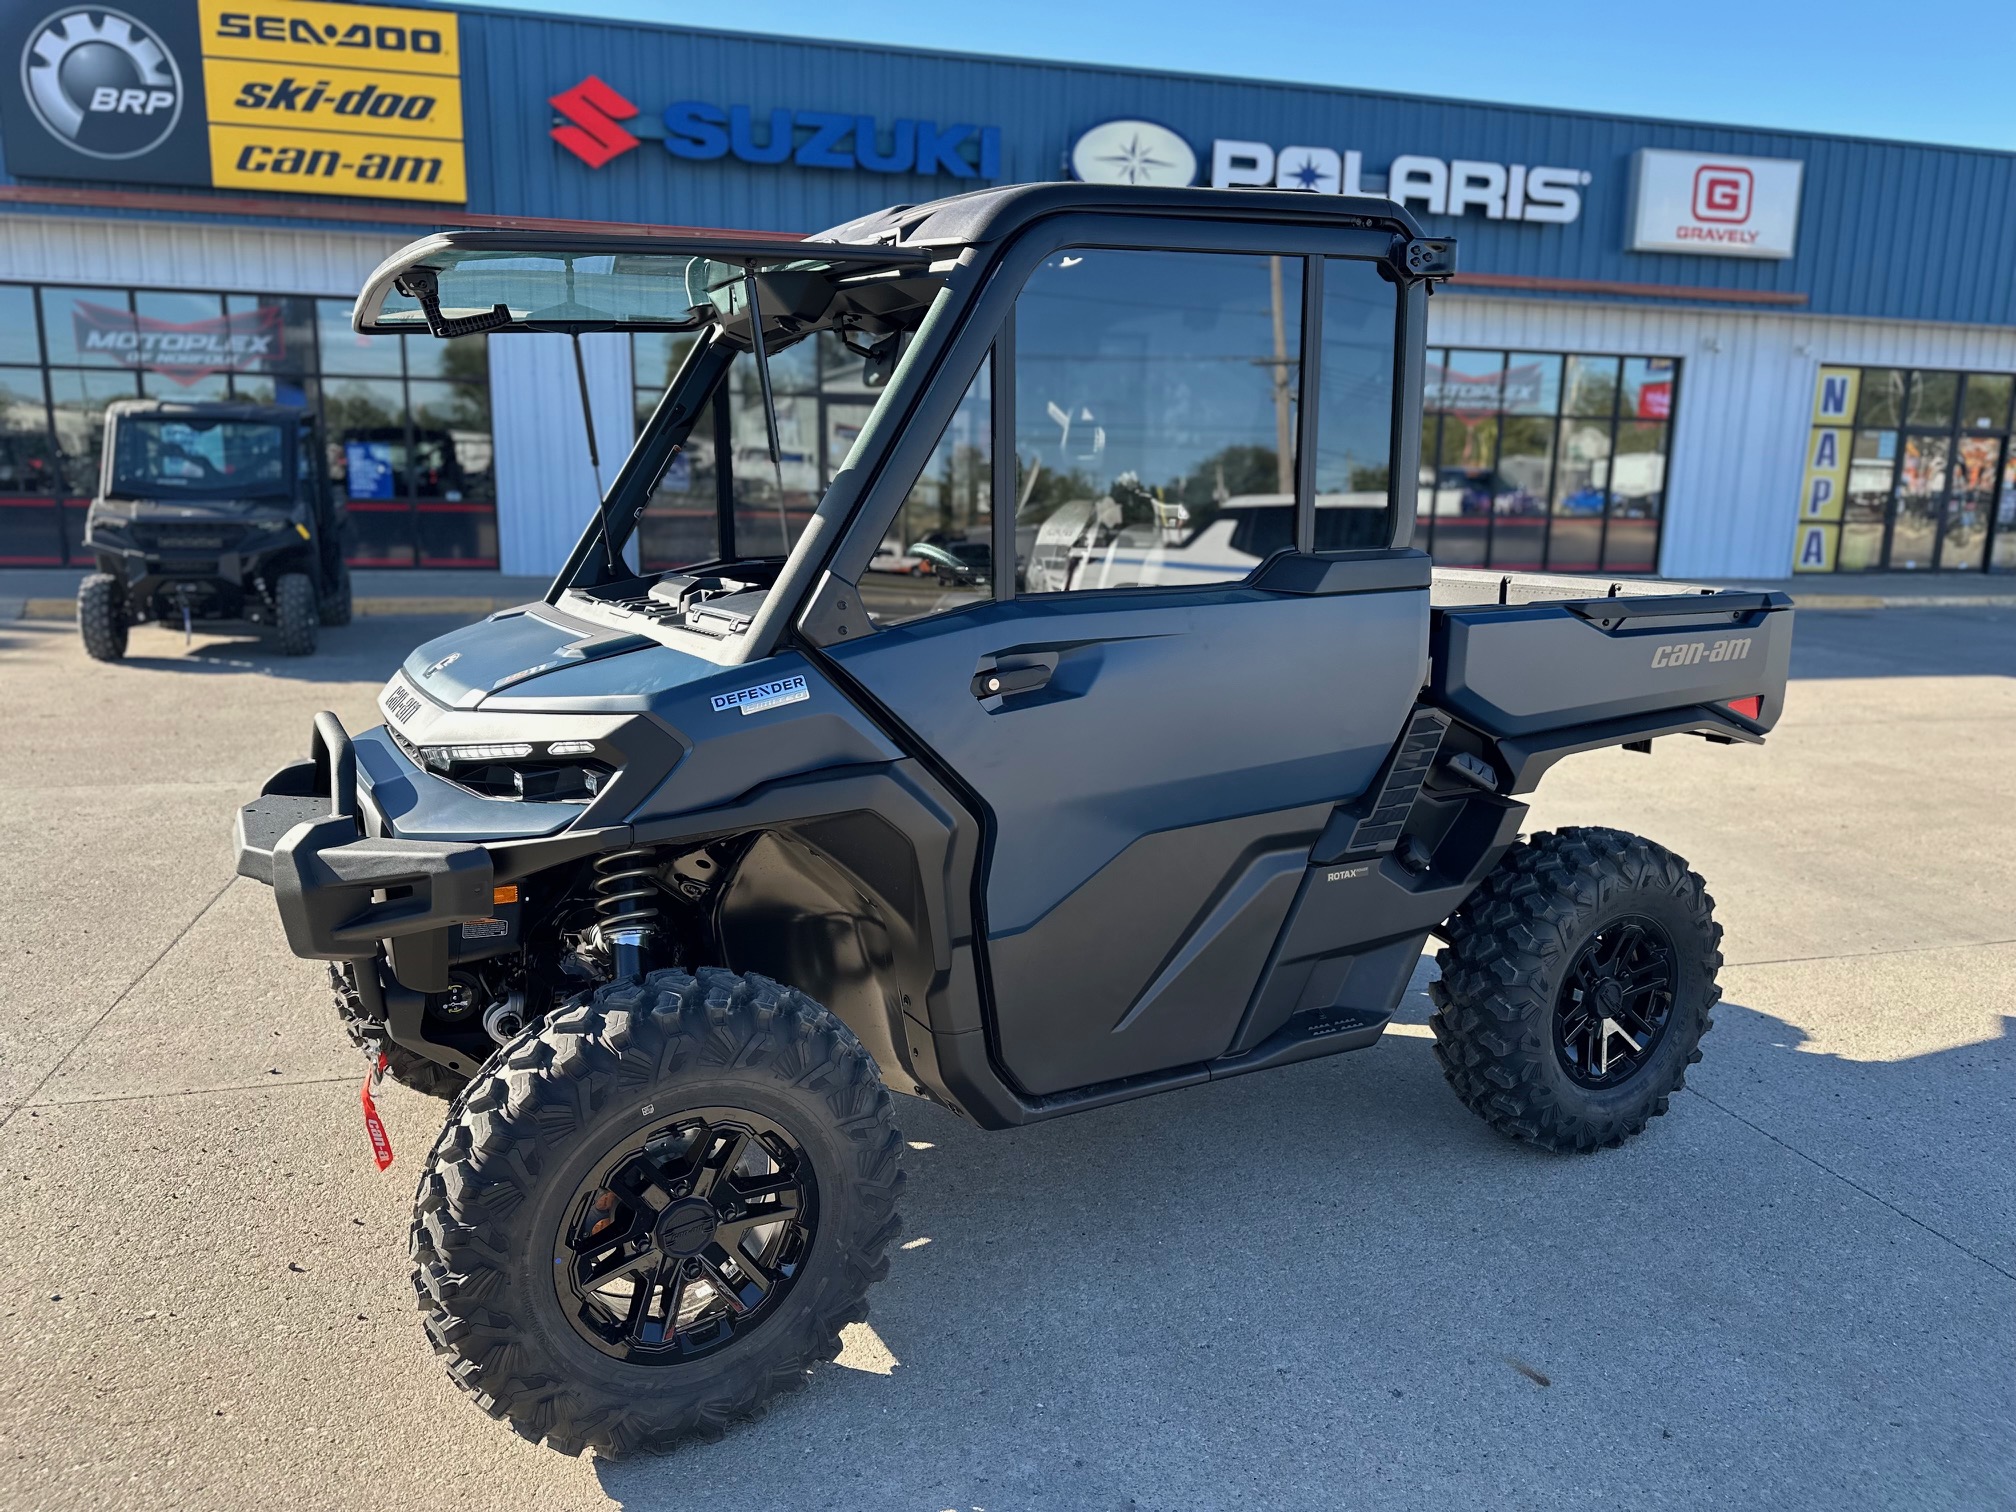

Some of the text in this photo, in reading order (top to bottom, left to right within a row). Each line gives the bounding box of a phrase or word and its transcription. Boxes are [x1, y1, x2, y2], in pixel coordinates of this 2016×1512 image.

[90, 86, 175, 116] BRP
[234, 77, 438, 122] ski-doo
[662, 100, 1003, 180] SUZUKI
[235, 145, 444, 186] can-am
[1211, 138, 1581, 224] POLARIS
[1675, 225, 1759, 244] GRAVELY
[86, 329, 273, 354] MOTOPLEX
[1801, 377, 1848, 566] NAPA
[1650, 637, 1752, 669] can-am
[713, 676, 805, 708] DEFENDER
[1327, 868, 1357, 882] ROTAX
